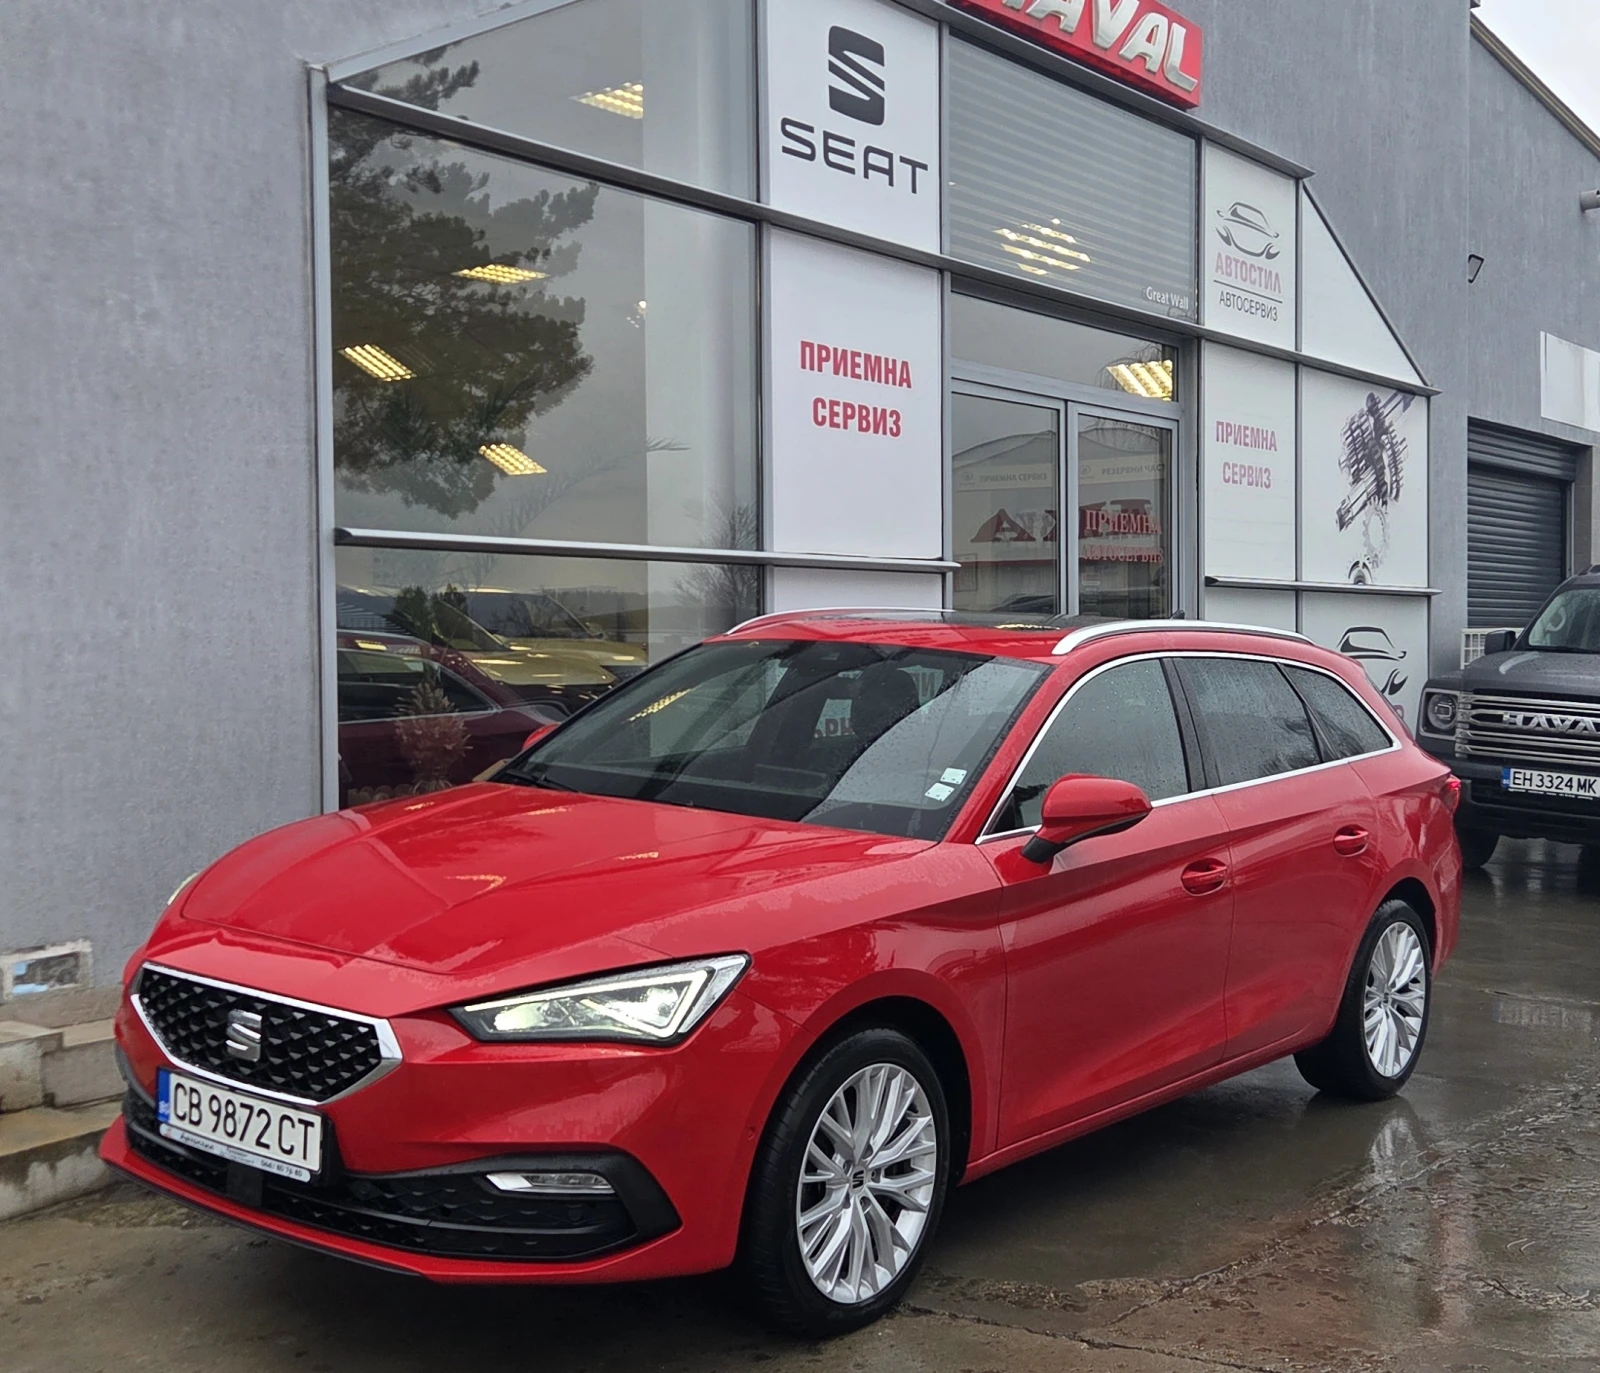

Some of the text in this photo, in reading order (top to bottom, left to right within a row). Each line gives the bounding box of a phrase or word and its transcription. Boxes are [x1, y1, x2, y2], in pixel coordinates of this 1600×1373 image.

[1000, 0, 1198, 92] AVAL
[780, 117, 928, 195] SEAT
[1215, 251, 1282, 294] АВТОСТИЛ
[1146, 286, 1189, 310] Great Wall
[1219, 290, 1278, 322] АВТОСЕРВИЗ
[800, 340, 912, 389] ПРИЕМНА
[813, 397, 901, 438] СЕРВИЗ
[1216, 420, 1278, 452] ПРИЕМНА
[1223, 461, 1271, 489] СЕРВИЗ
[1085, 509, 1163, 535] ПРИЕМНА
[1512, 771, 1597, 794] EH 3324 MK
[173, 1082, 202, 1126] CB
[208, 1095, 272, 1149] 9872
[278, 1114, 315, 1161] CT
